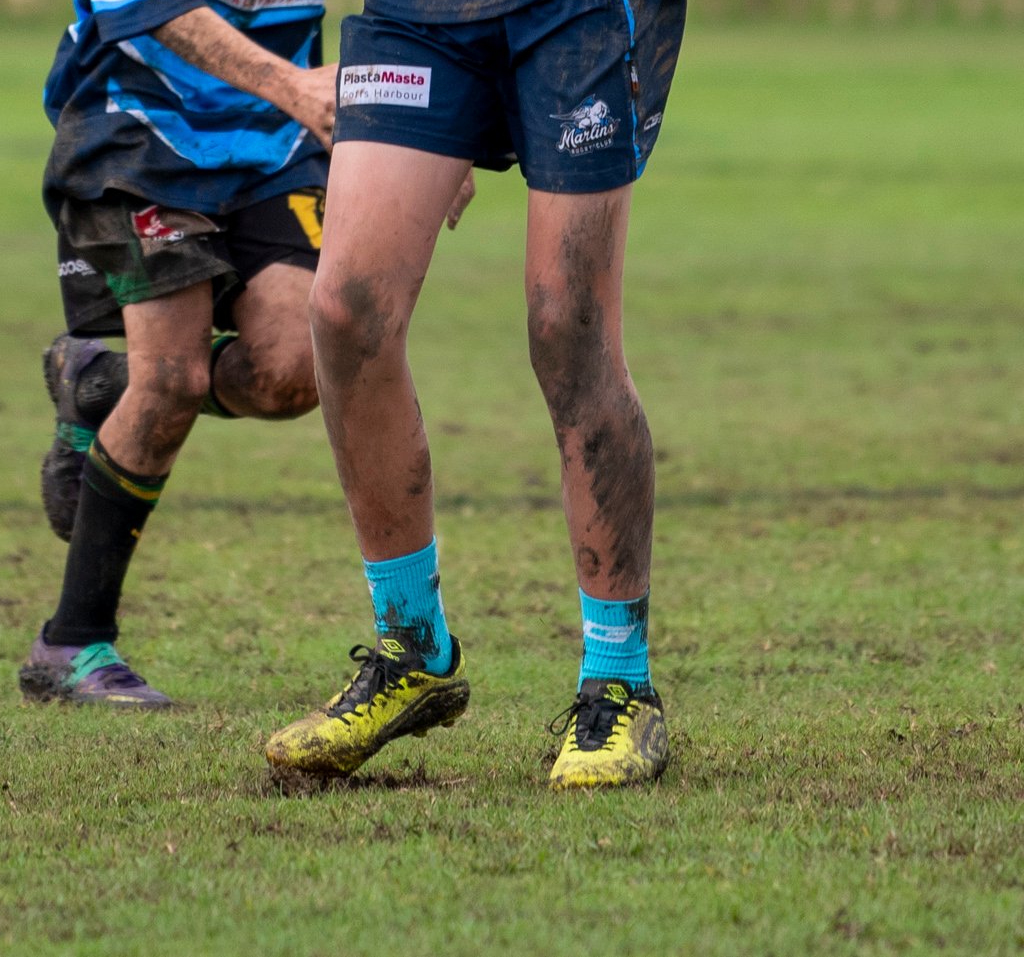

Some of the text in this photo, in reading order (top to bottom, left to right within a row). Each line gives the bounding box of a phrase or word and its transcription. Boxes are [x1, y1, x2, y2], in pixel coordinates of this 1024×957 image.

[343, 71, 425, 86] PlastaMasta
[342, 88, 423, 101] Coffs Harbour
[558, 123, 614, 150] Marlins
